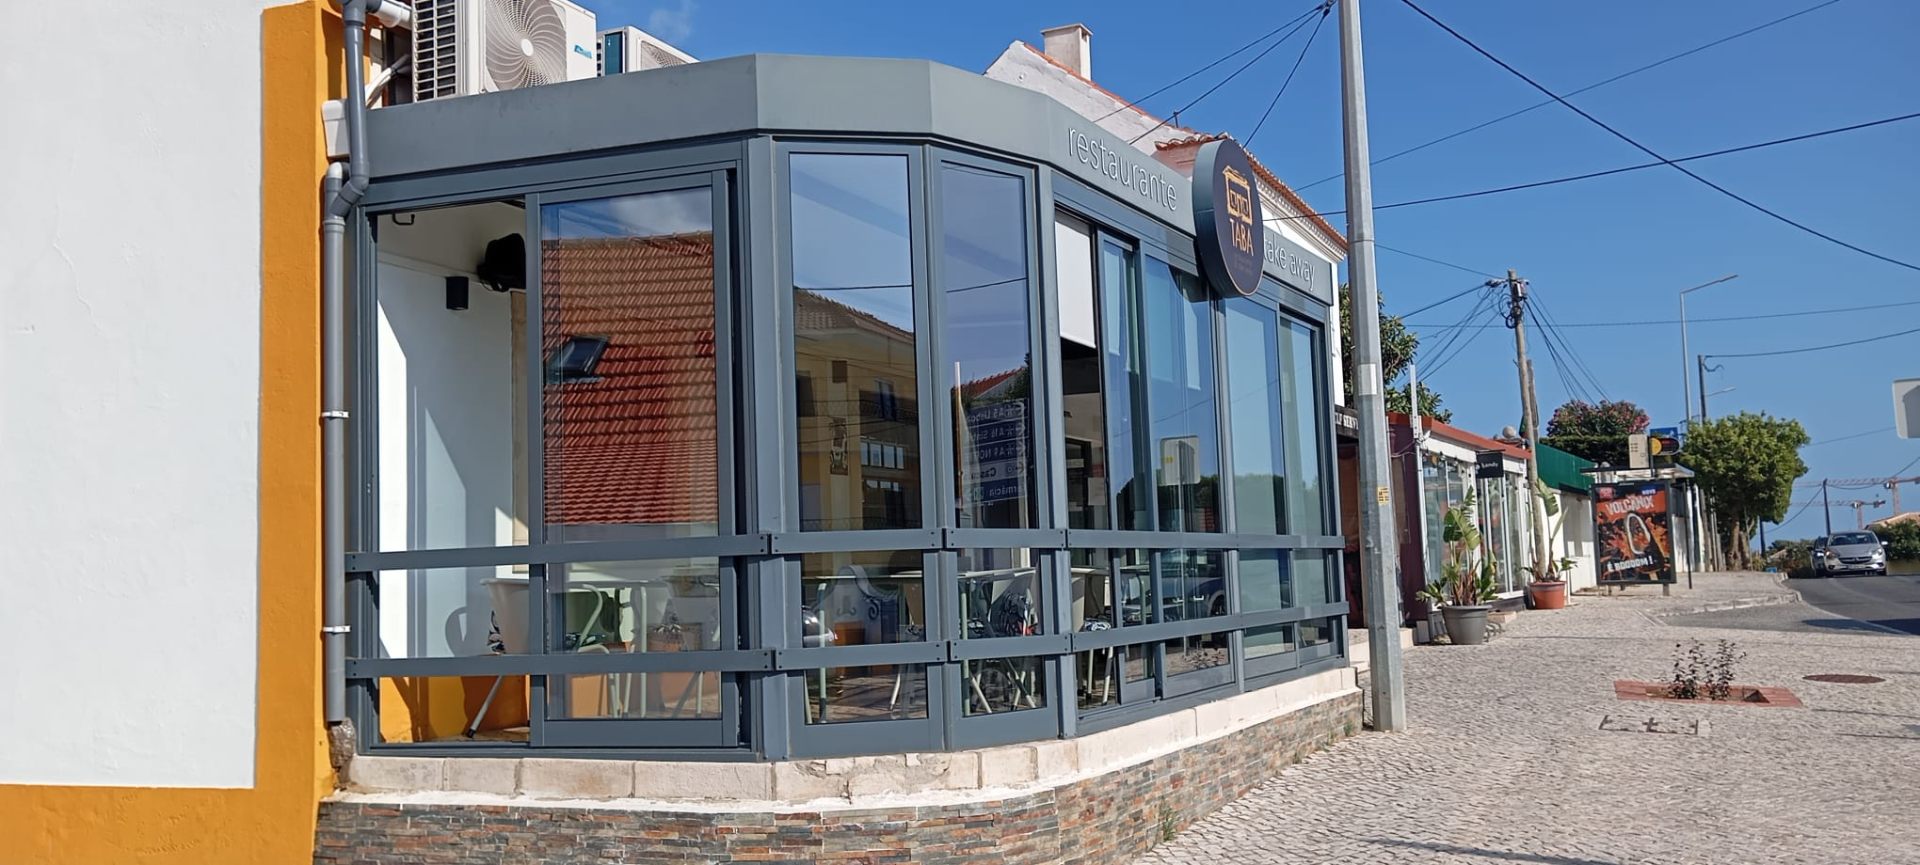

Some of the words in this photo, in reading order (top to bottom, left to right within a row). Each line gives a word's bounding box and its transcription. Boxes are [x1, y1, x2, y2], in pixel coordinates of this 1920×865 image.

[1068, 127, 1177, 211] restaurante
[1229, 218, 1254, 257] TABA
[1290, 253, 1315, 291] away
